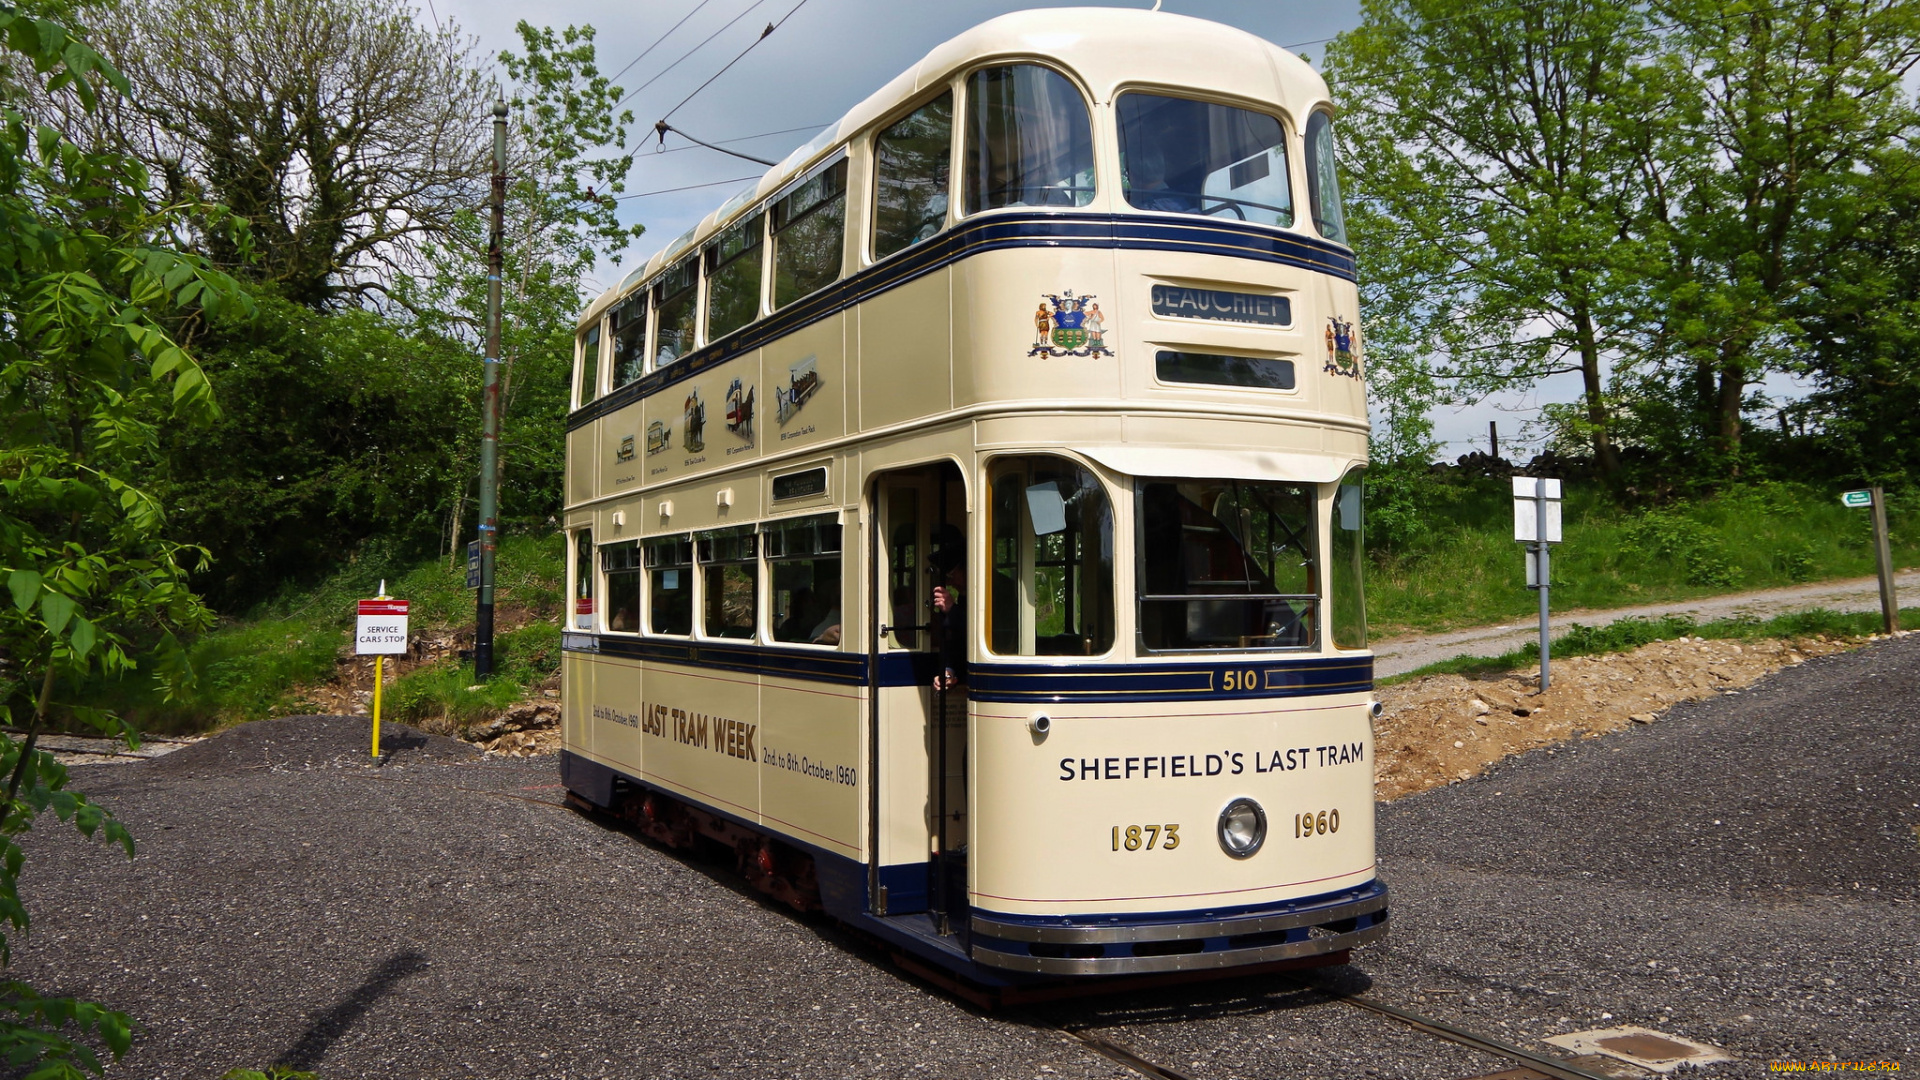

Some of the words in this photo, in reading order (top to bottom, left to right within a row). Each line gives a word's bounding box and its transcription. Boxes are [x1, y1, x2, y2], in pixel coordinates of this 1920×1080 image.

[367, 626, 399, 634] SERVICE
[1222, 670, 1257, 692] 510
[642, 701, 668, 738] LAST
[671, 708, 708, 749] TRAM
[713, 716, 757, 762] WEEK
[763, 747, 777, 766] 2nd.
[778, 753, 785, 769] to
[836, 764, 856, 787] 1960
[1060, 750, 1244, 781] SHEFFIELD'S
[1256, 748, 1311, 773] LAST
[1316, 742, 1364, 767] TRAM
[1111, 823, 1180, 851] 1873
[1294, 808, 1340, 839] 1960
